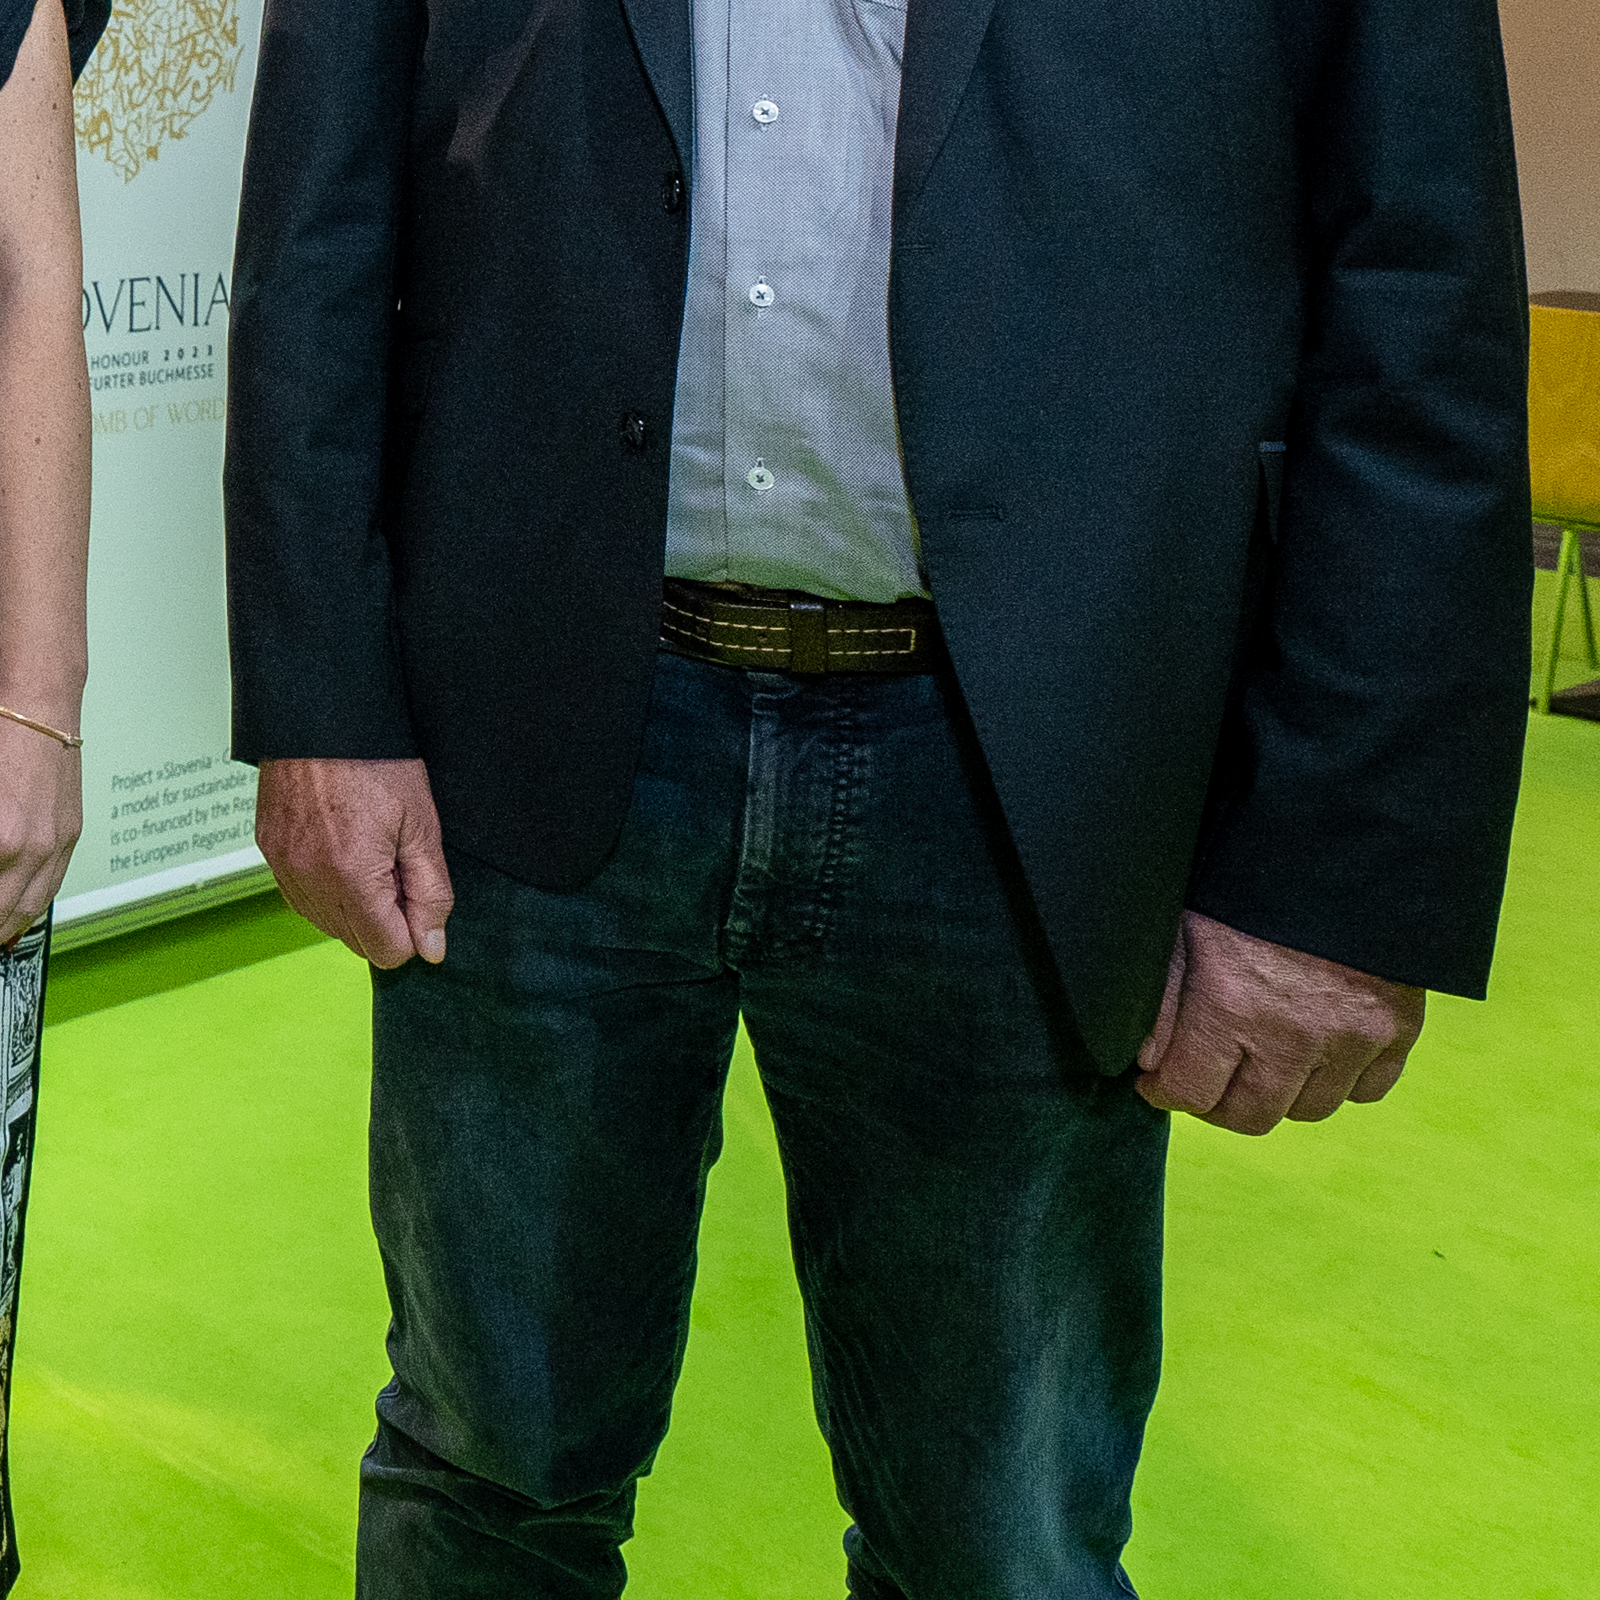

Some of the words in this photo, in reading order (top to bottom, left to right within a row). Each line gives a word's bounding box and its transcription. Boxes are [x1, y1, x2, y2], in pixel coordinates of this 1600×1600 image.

[90, 349, 150, 371] HONOUR
[139, 362, 215, 387] BUCHMESSE
[110, 768, 153, 792] Project
[121, 791, 160, 816] model
[162, 786, 180, 806] for
[133, 839, 190, 867] European
